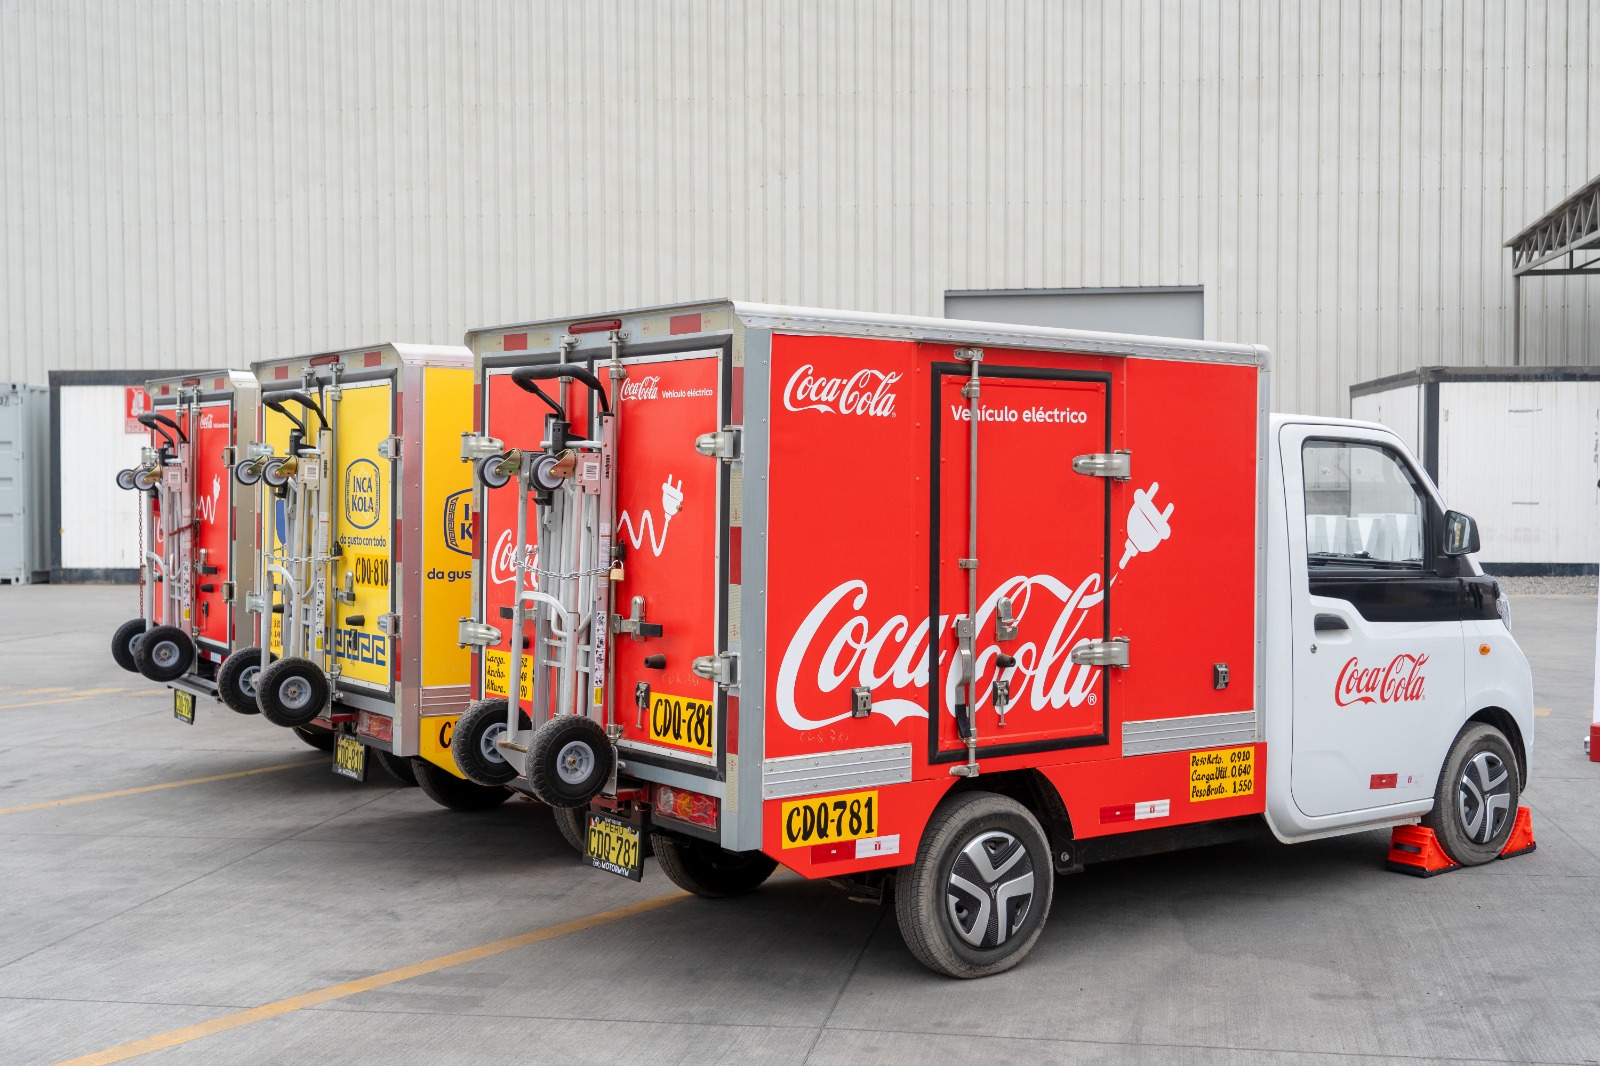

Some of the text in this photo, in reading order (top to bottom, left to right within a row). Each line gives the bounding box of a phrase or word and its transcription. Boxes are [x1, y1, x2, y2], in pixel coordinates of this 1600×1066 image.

[621, 376, 660, 400] Coca-Cola
[784, 364, 903, 417] Coca-Cola
[1022, 407, 1087, 423] eléctrico
[353, 476, 373, 493] INCA
[351, 495, 374, 513] KOLA
[340, 534, 387, 548] da gusto con todo
[355, 557, 389, 587] CDQ-810
[427, 568, 472, 582] da gus
[1335, 653, 1430, 707] Coca-Cola
[653, 698, 713, 748] CDQ-781
[1230, 750, 1251, 763] 0,910
[1230, 763, 1252, 778] 0,640
[1232, 779, 1253, 795] 1,550
[786, 796, 874, 843] CDQ-781
[588, 827, 638, 870] CDQ-781
